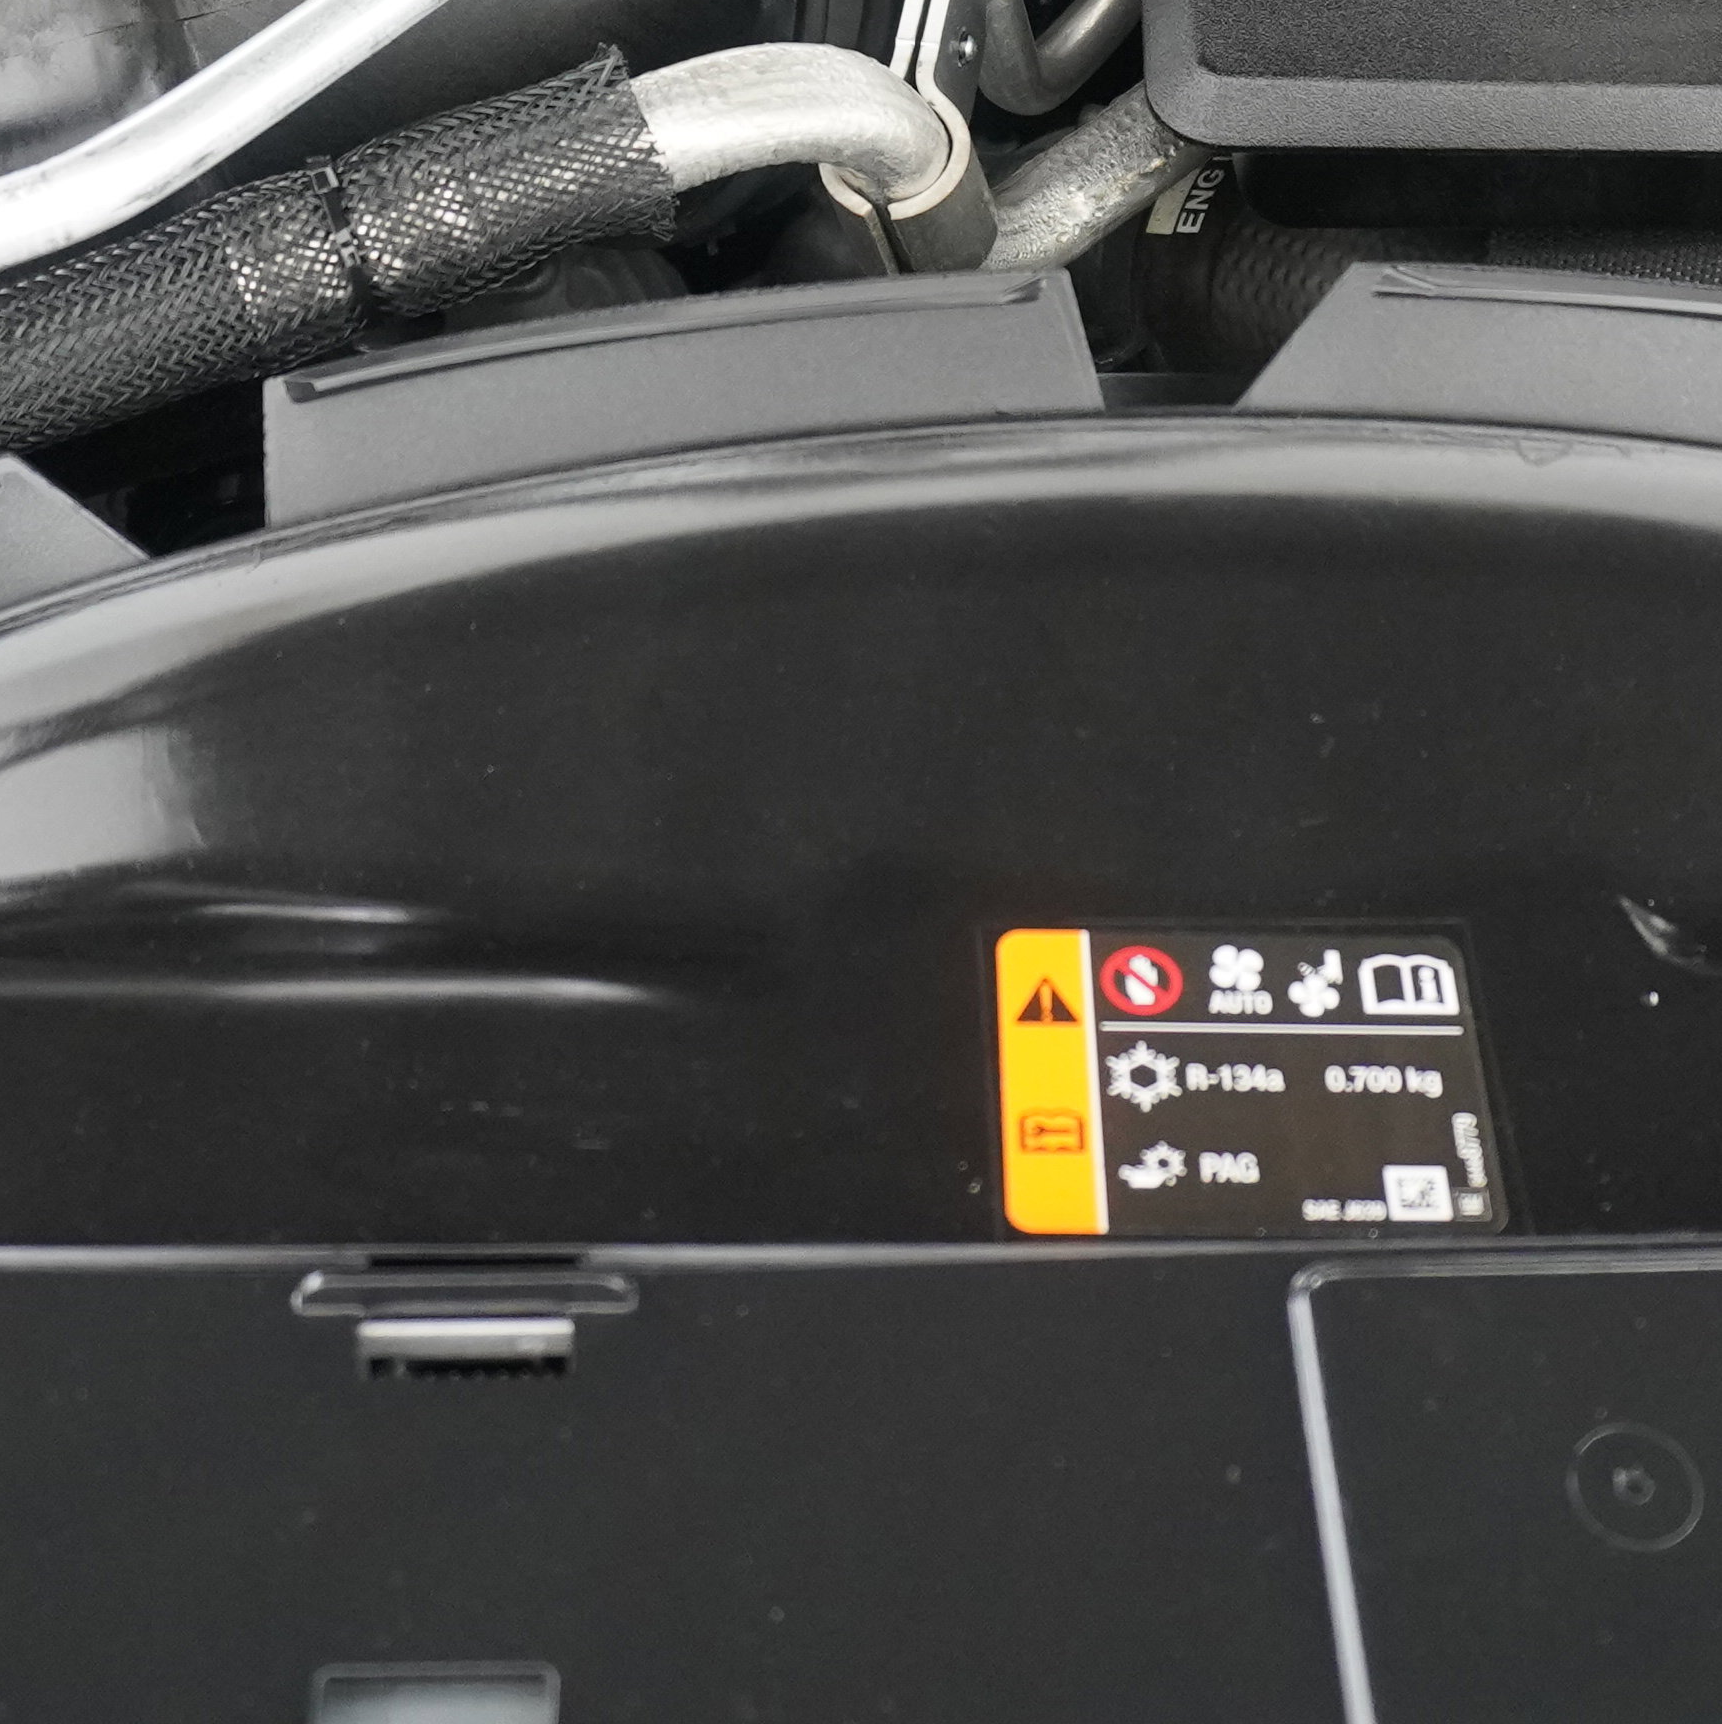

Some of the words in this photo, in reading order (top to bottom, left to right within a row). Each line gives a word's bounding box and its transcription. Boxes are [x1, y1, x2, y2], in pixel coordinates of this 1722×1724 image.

[1209, 990, 1272, 1014] AUTO
[1186, 1064, 1284, 1092] R-134a
[1325, 1065, 1401, 1093] 0.700
[1406, 1066, 1443, 1098] kg
[1199, 1152, 1261, 1184] PAG
